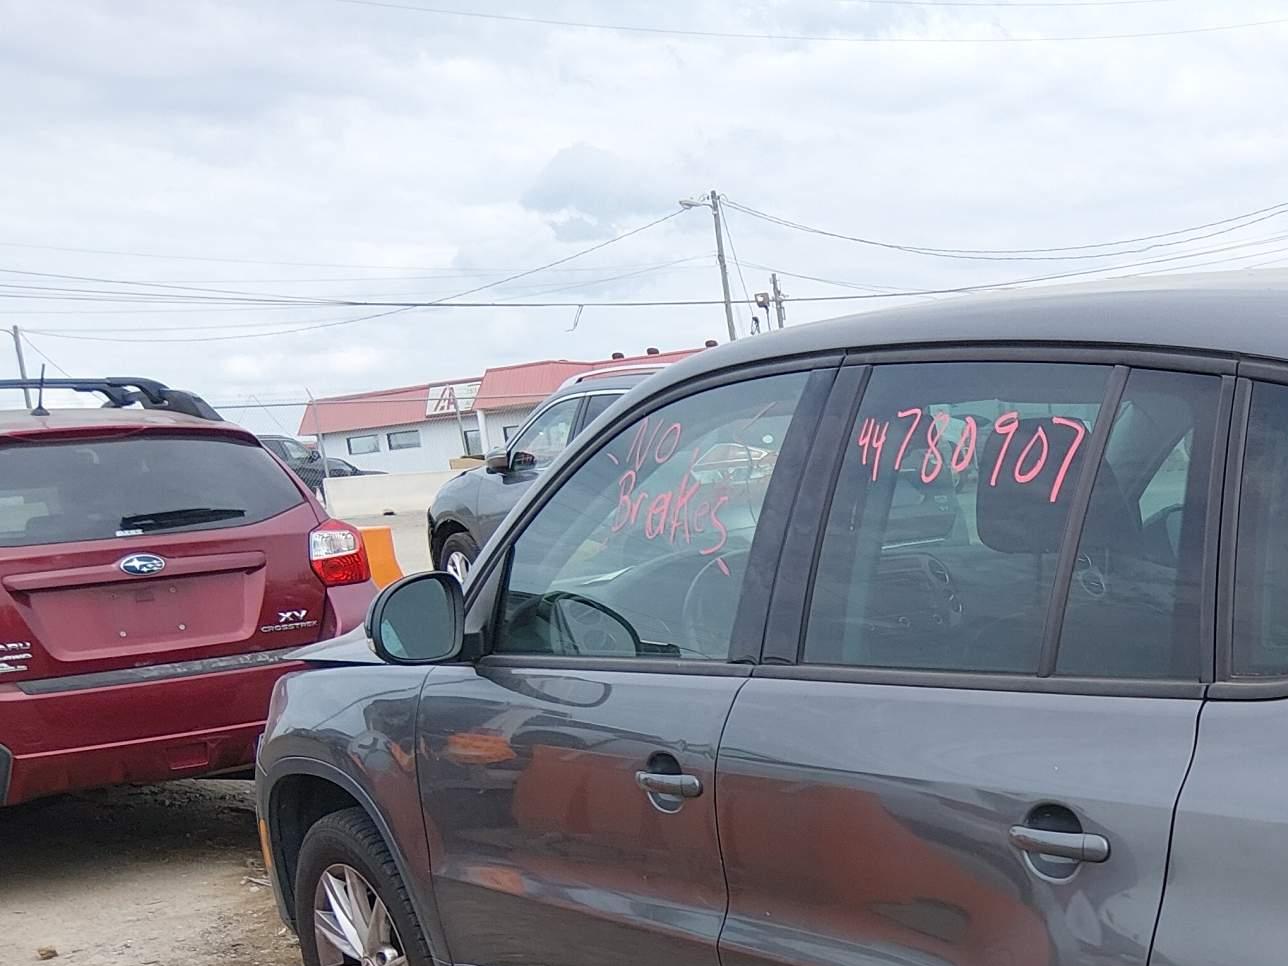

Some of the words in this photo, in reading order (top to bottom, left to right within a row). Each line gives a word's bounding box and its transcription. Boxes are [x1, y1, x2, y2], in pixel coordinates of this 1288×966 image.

[625, 415, 681, 472] NO
[858, 408, 1087, 503] 44780907
[260, 619, 318, 633] CROSSTREK
[277, 609, 308, 623] XV
